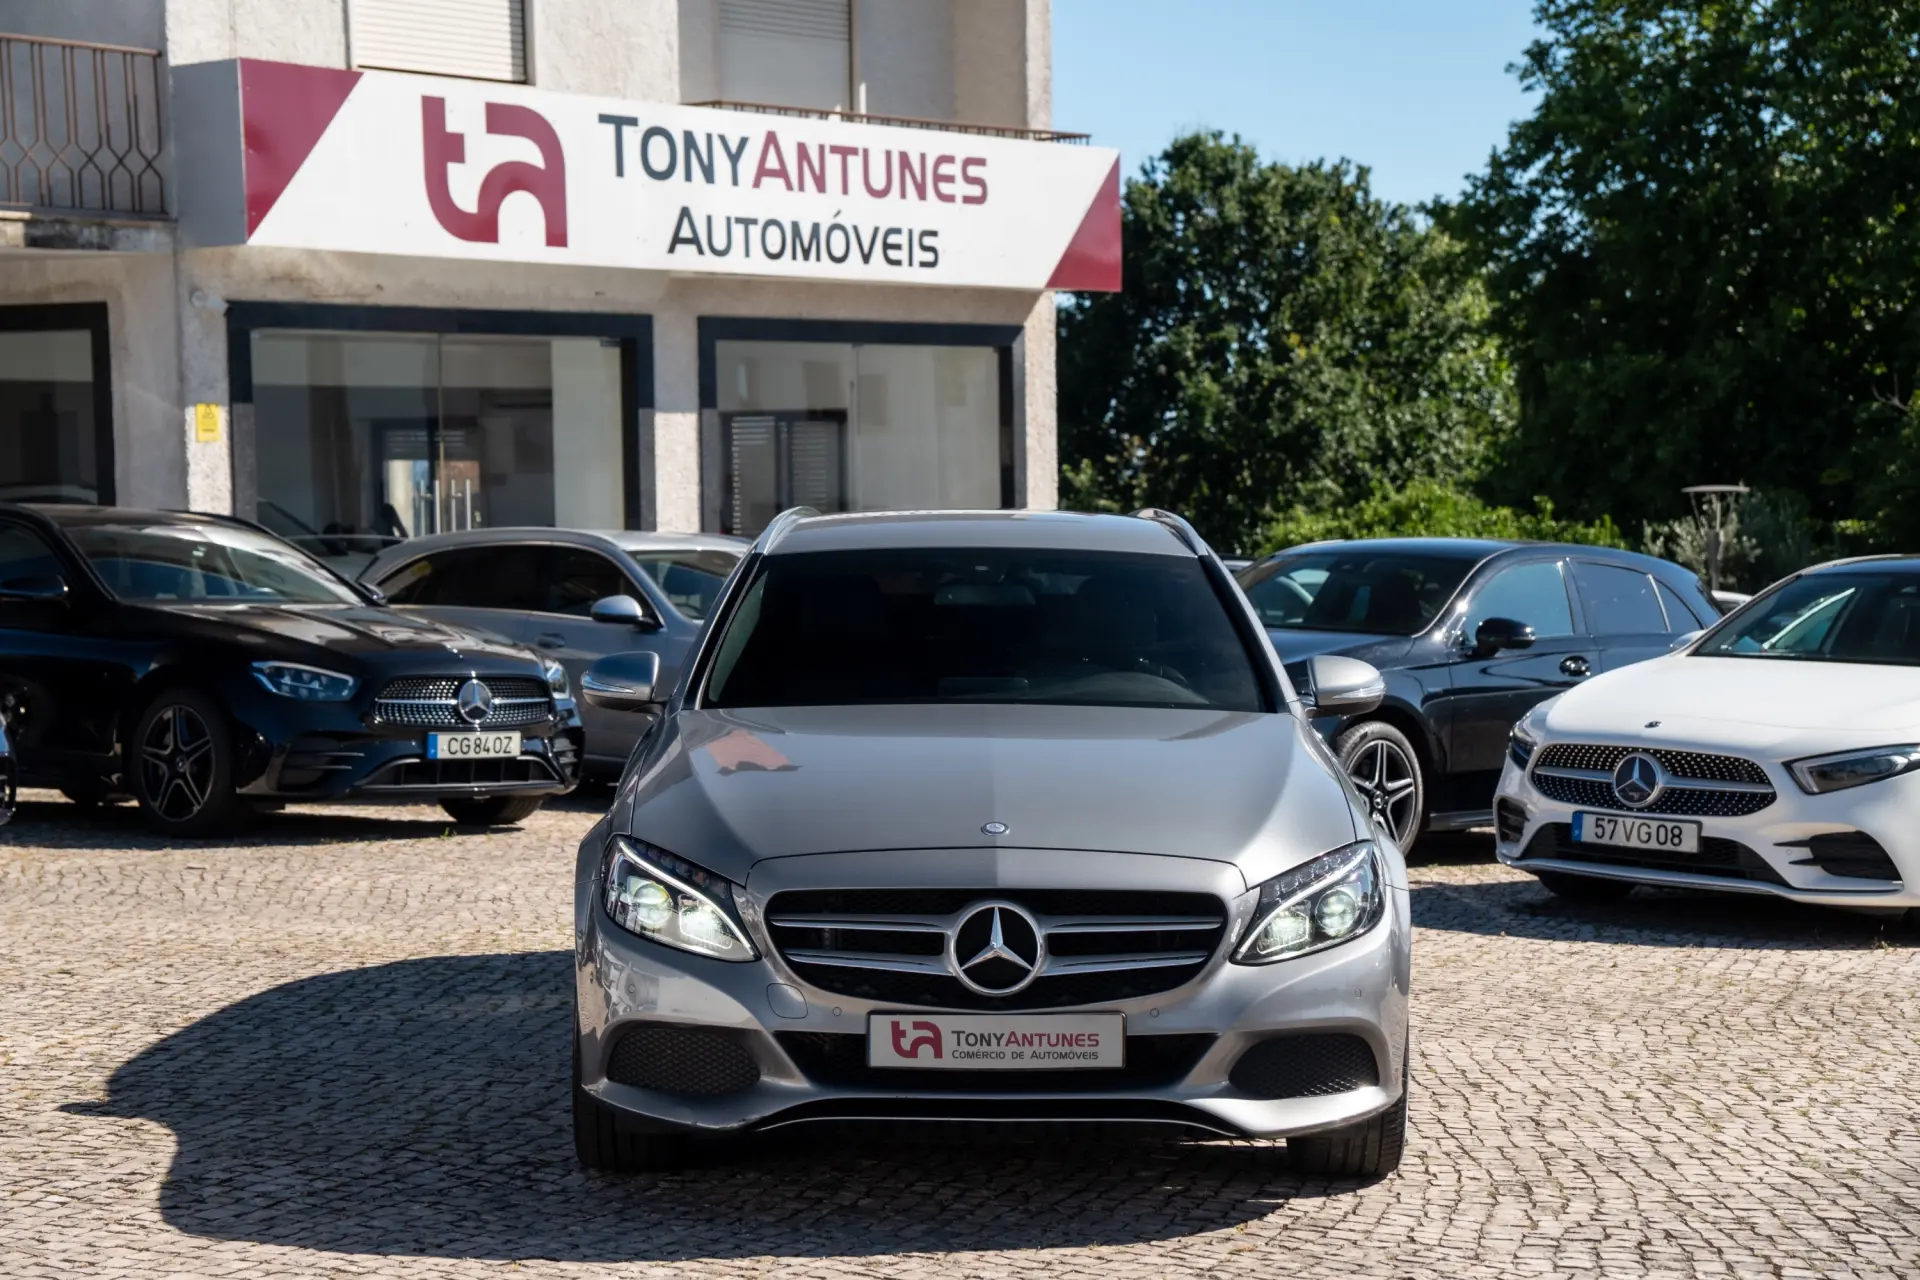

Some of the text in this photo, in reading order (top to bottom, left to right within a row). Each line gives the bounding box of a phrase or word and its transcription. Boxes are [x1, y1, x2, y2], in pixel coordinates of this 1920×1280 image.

[668, 206, 939, 268] AUTOMÓVEIS
[951, 1048, 1099, 1060] COMÉRCIO DE AUTOMÓVEIS
